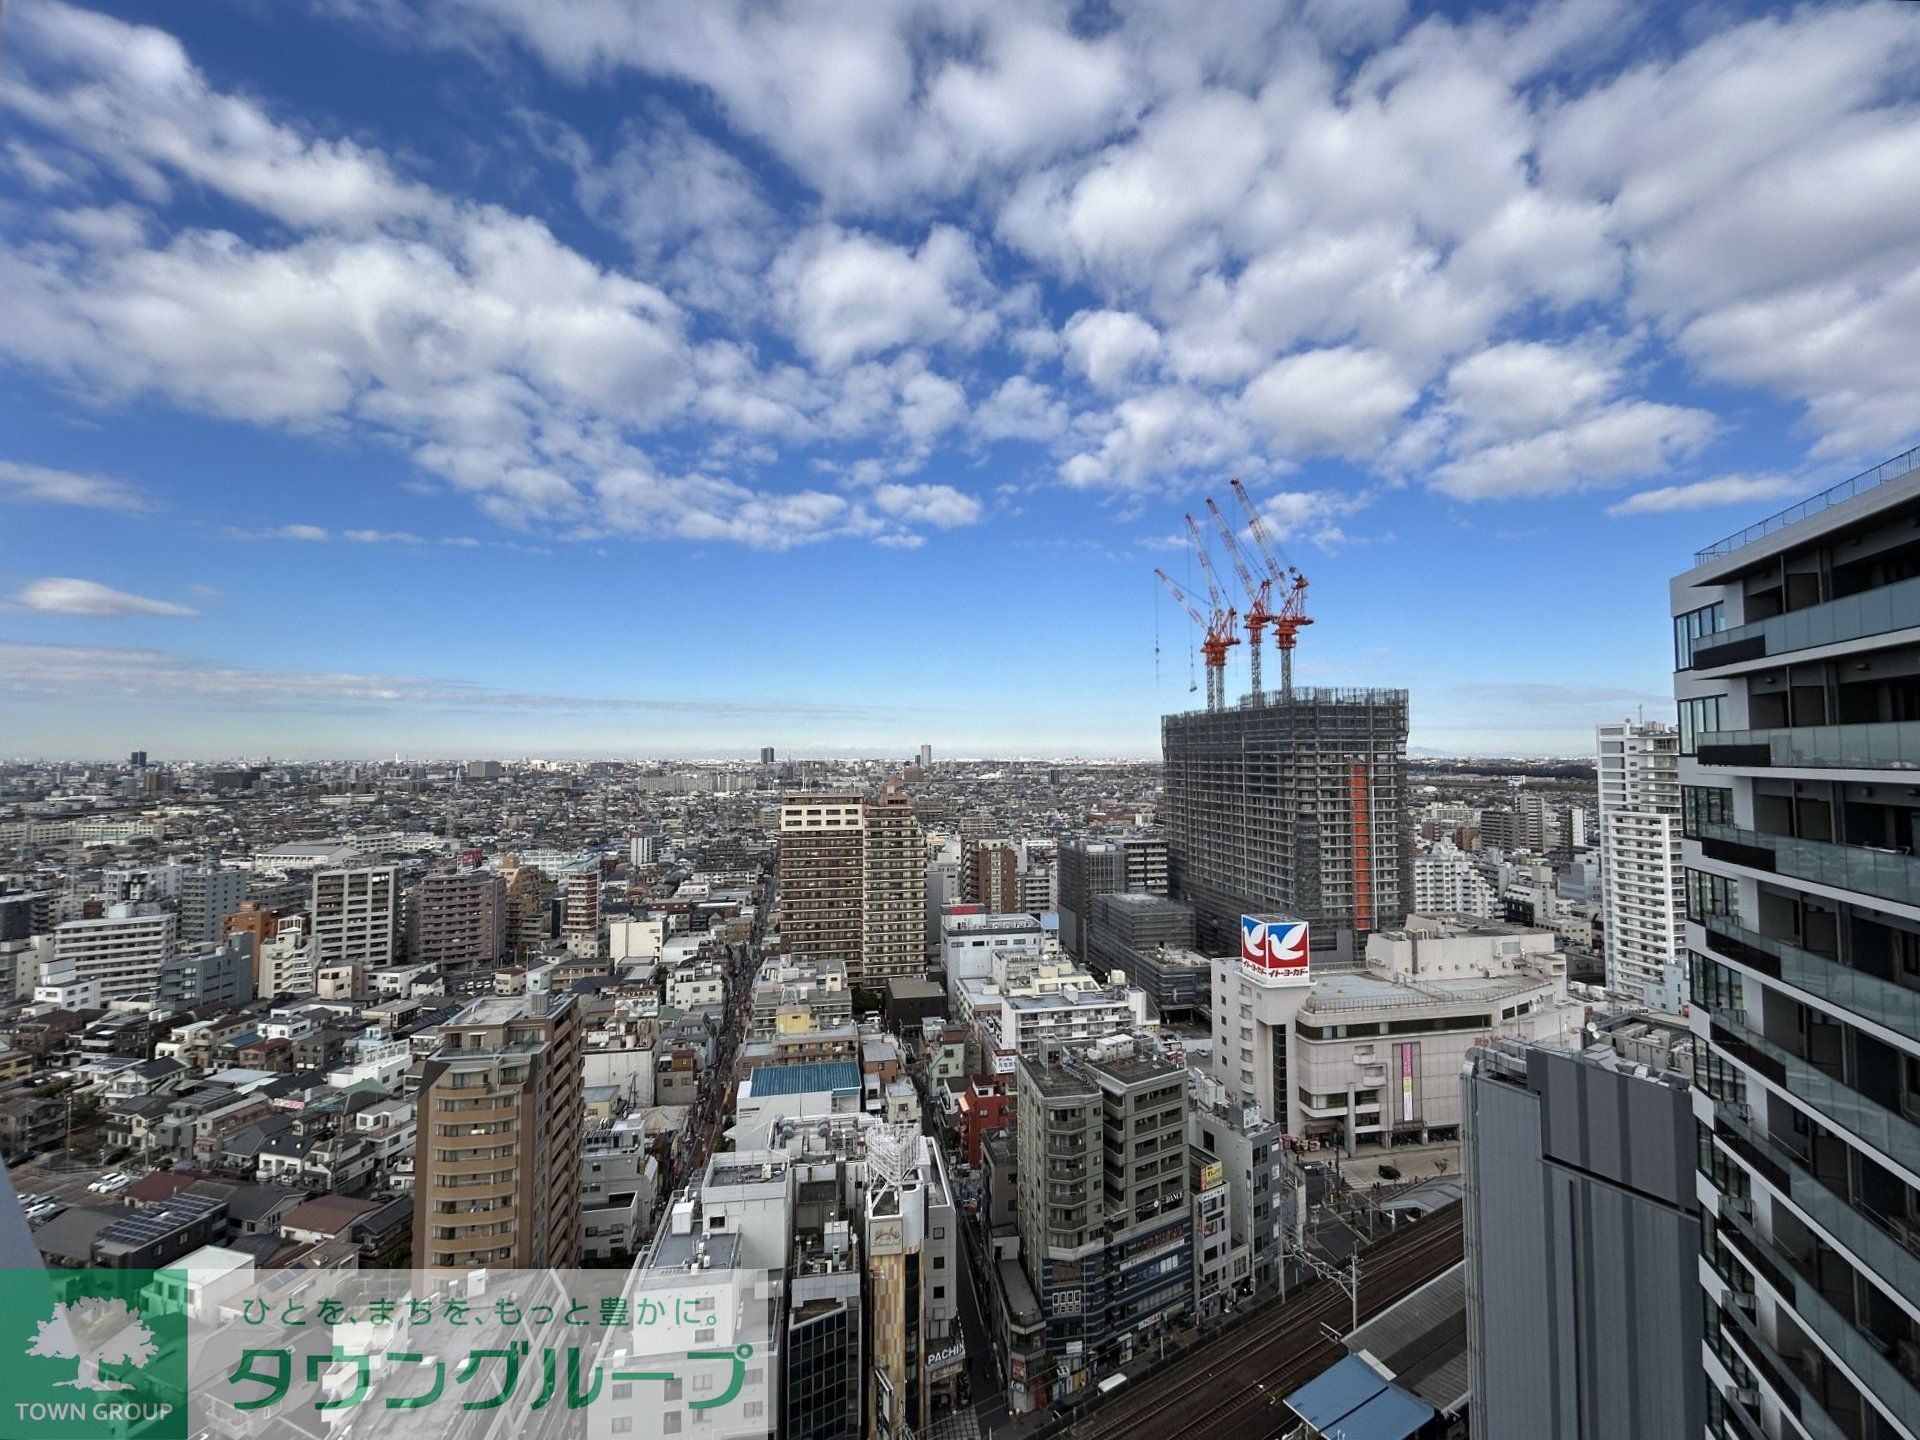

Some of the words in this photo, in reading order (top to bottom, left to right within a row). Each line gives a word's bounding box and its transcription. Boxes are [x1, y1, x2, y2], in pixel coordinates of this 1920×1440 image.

[1268, 968, 1308, 977] イトーヨーカドー
